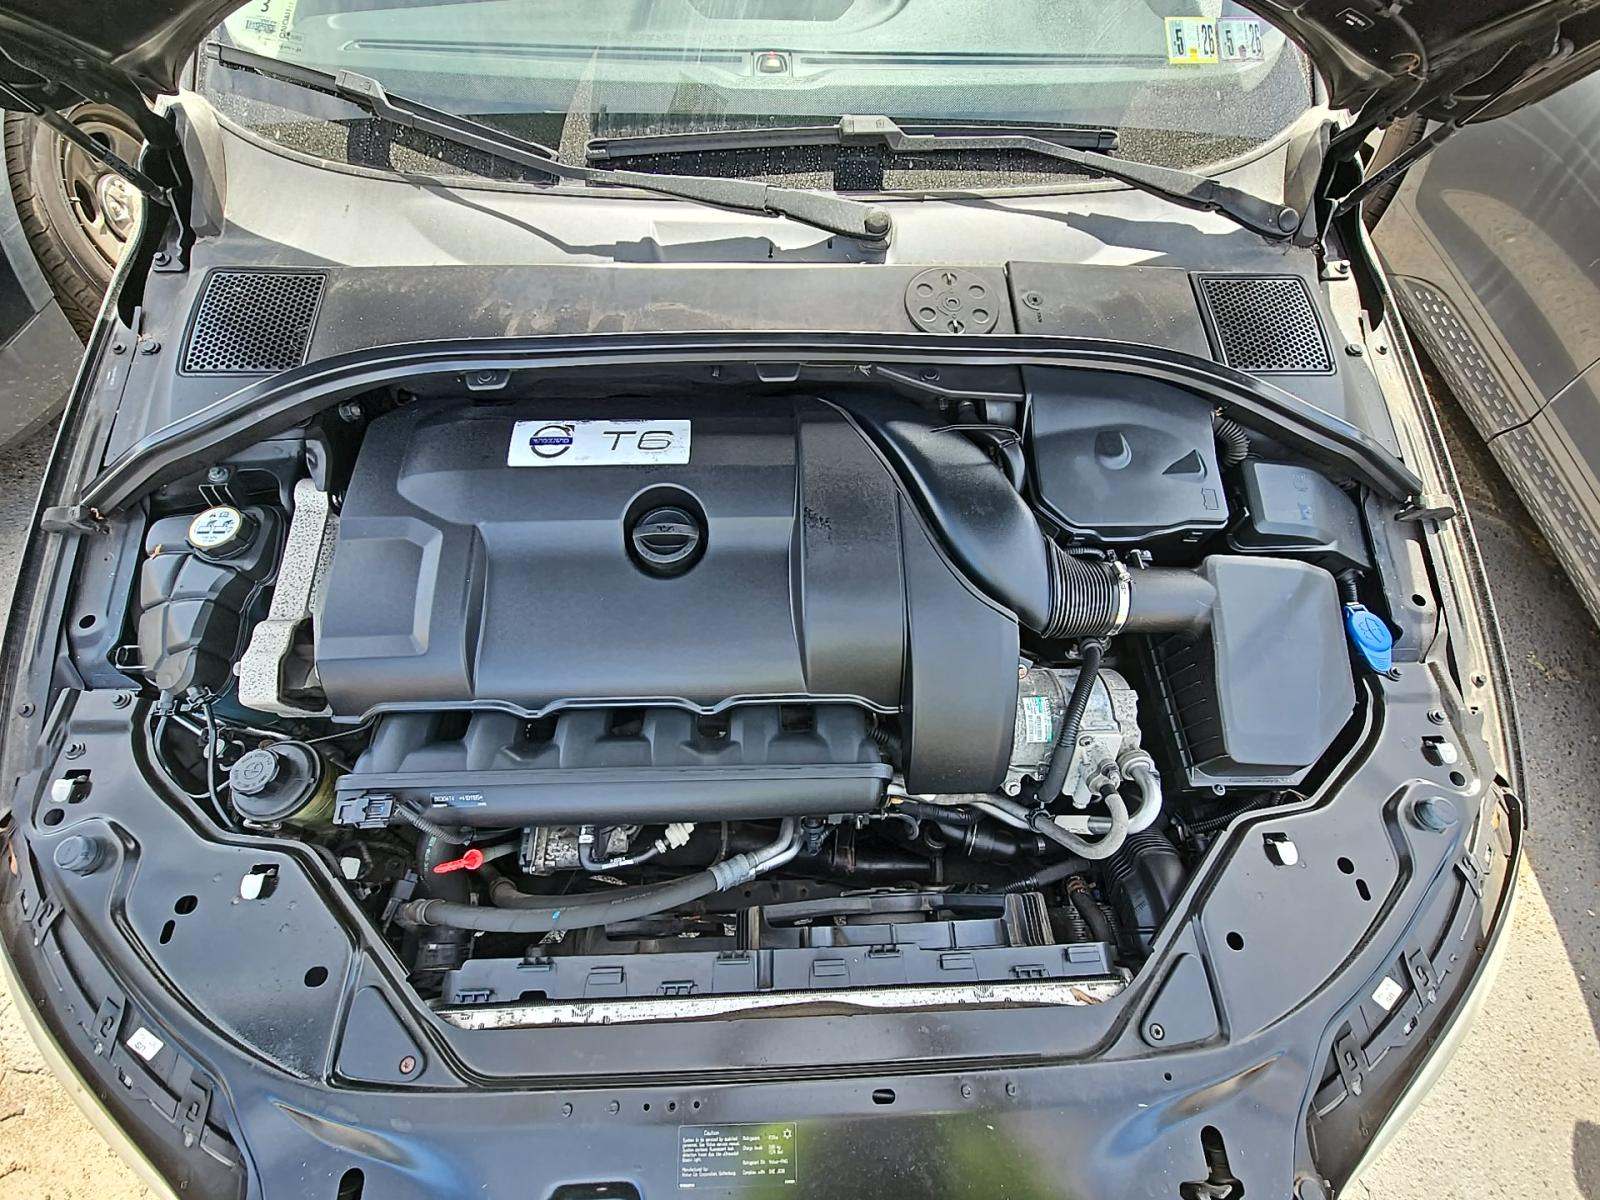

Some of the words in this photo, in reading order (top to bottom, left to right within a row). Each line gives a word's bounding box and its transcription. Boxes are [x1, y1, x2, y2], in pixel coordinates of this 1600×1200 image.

[1175, 29, 1184, 55] 5
[1201, 24, 1215, 55] 26
[1225, 30, 1234, 56] 5
[1249, 24, 1261, 54] 26
[603, 430, 674, 451] T6
